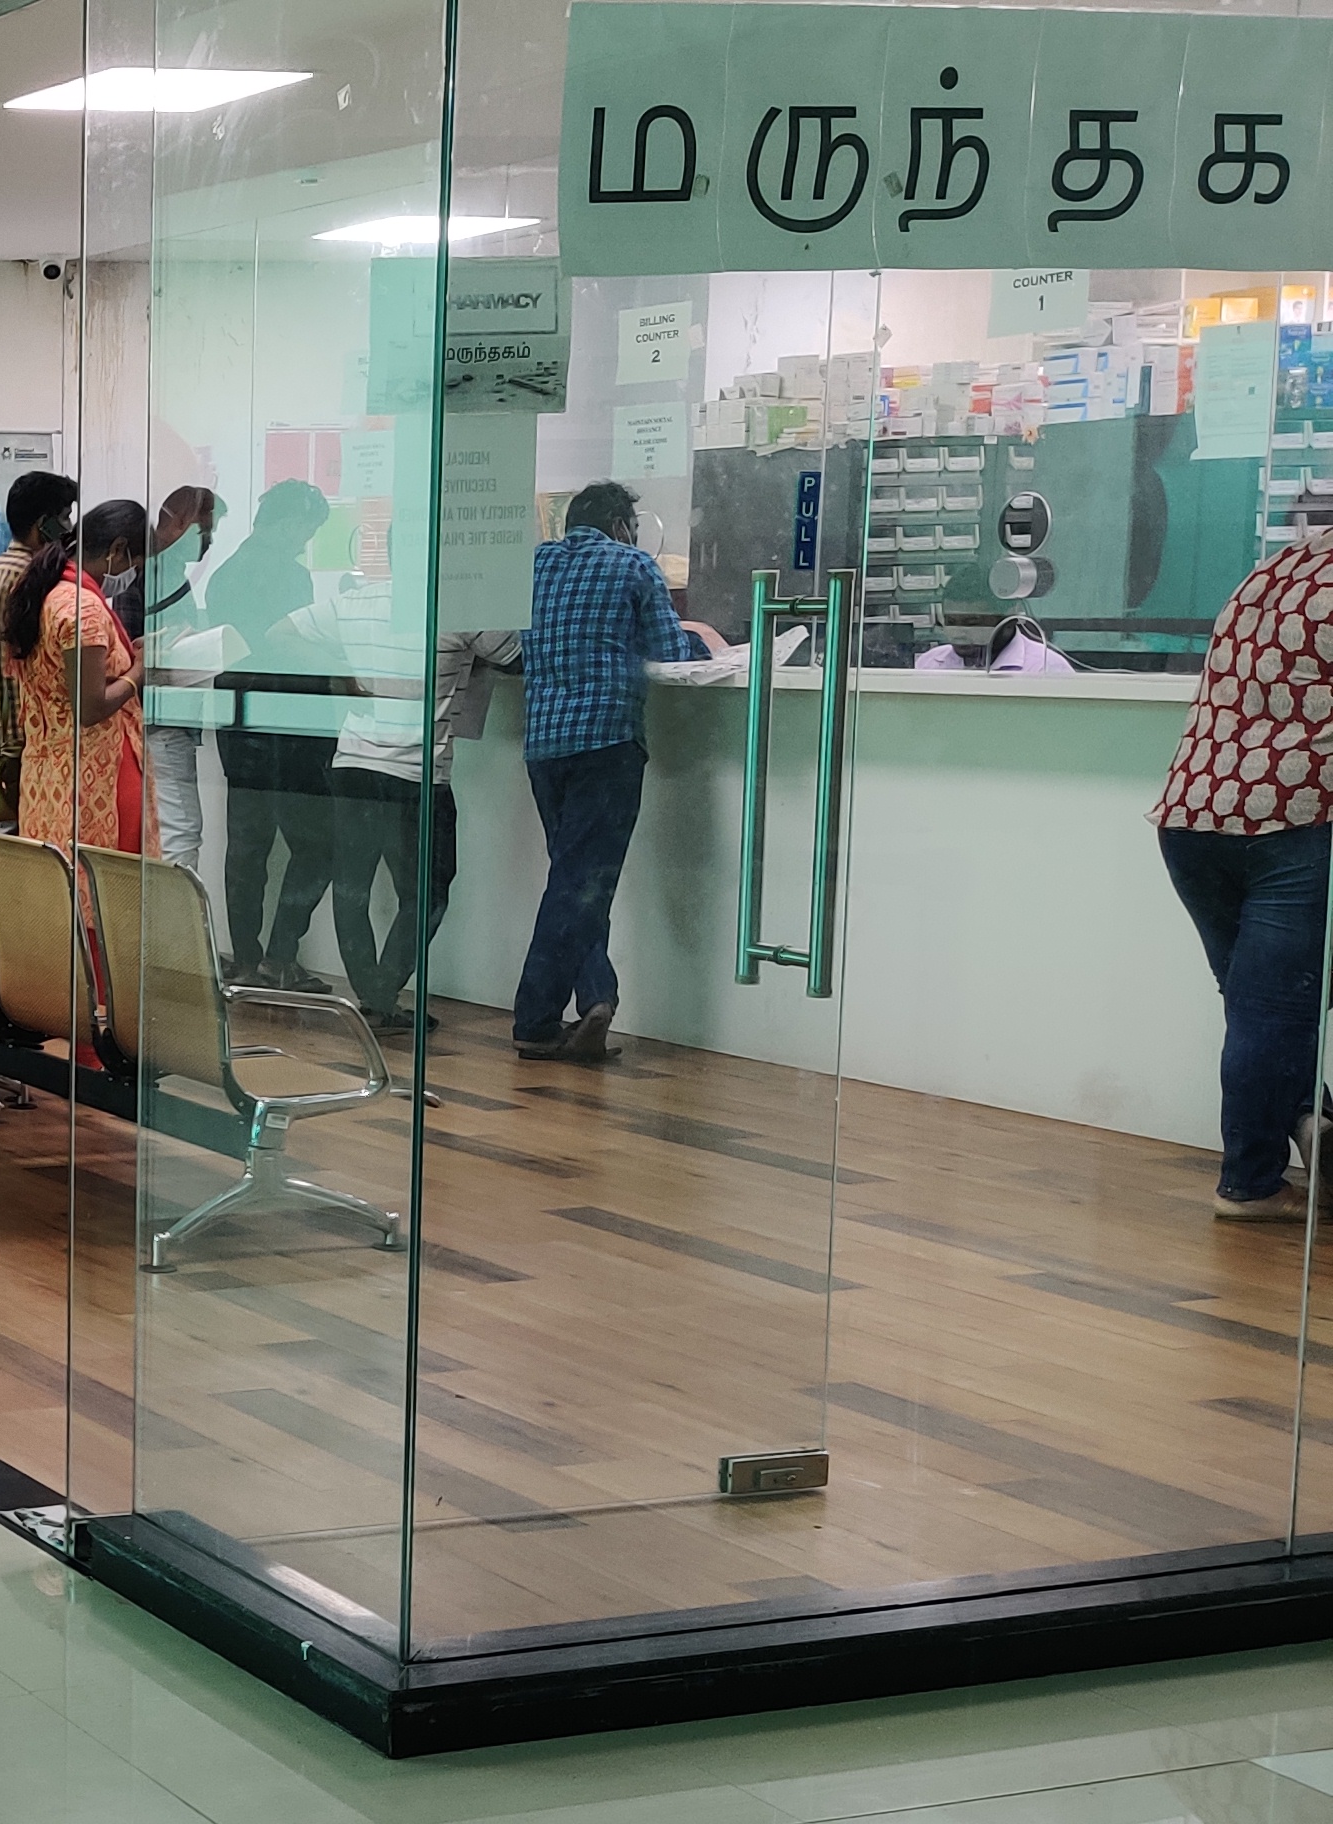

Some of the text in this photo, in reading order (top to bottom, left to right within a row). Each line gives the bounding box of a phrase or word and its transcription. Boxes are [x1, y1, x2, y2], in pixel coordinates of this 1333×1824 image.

[1012, 270, 1073, 289] COUNTER
[1038, 295, 1044, 311] 1
[639, 313, 675, 327] BILLING
[635, 329, 679, 343] COUNTER
[651, 349, 660, 363] 2
[799, 477, 815, 566] PULL
